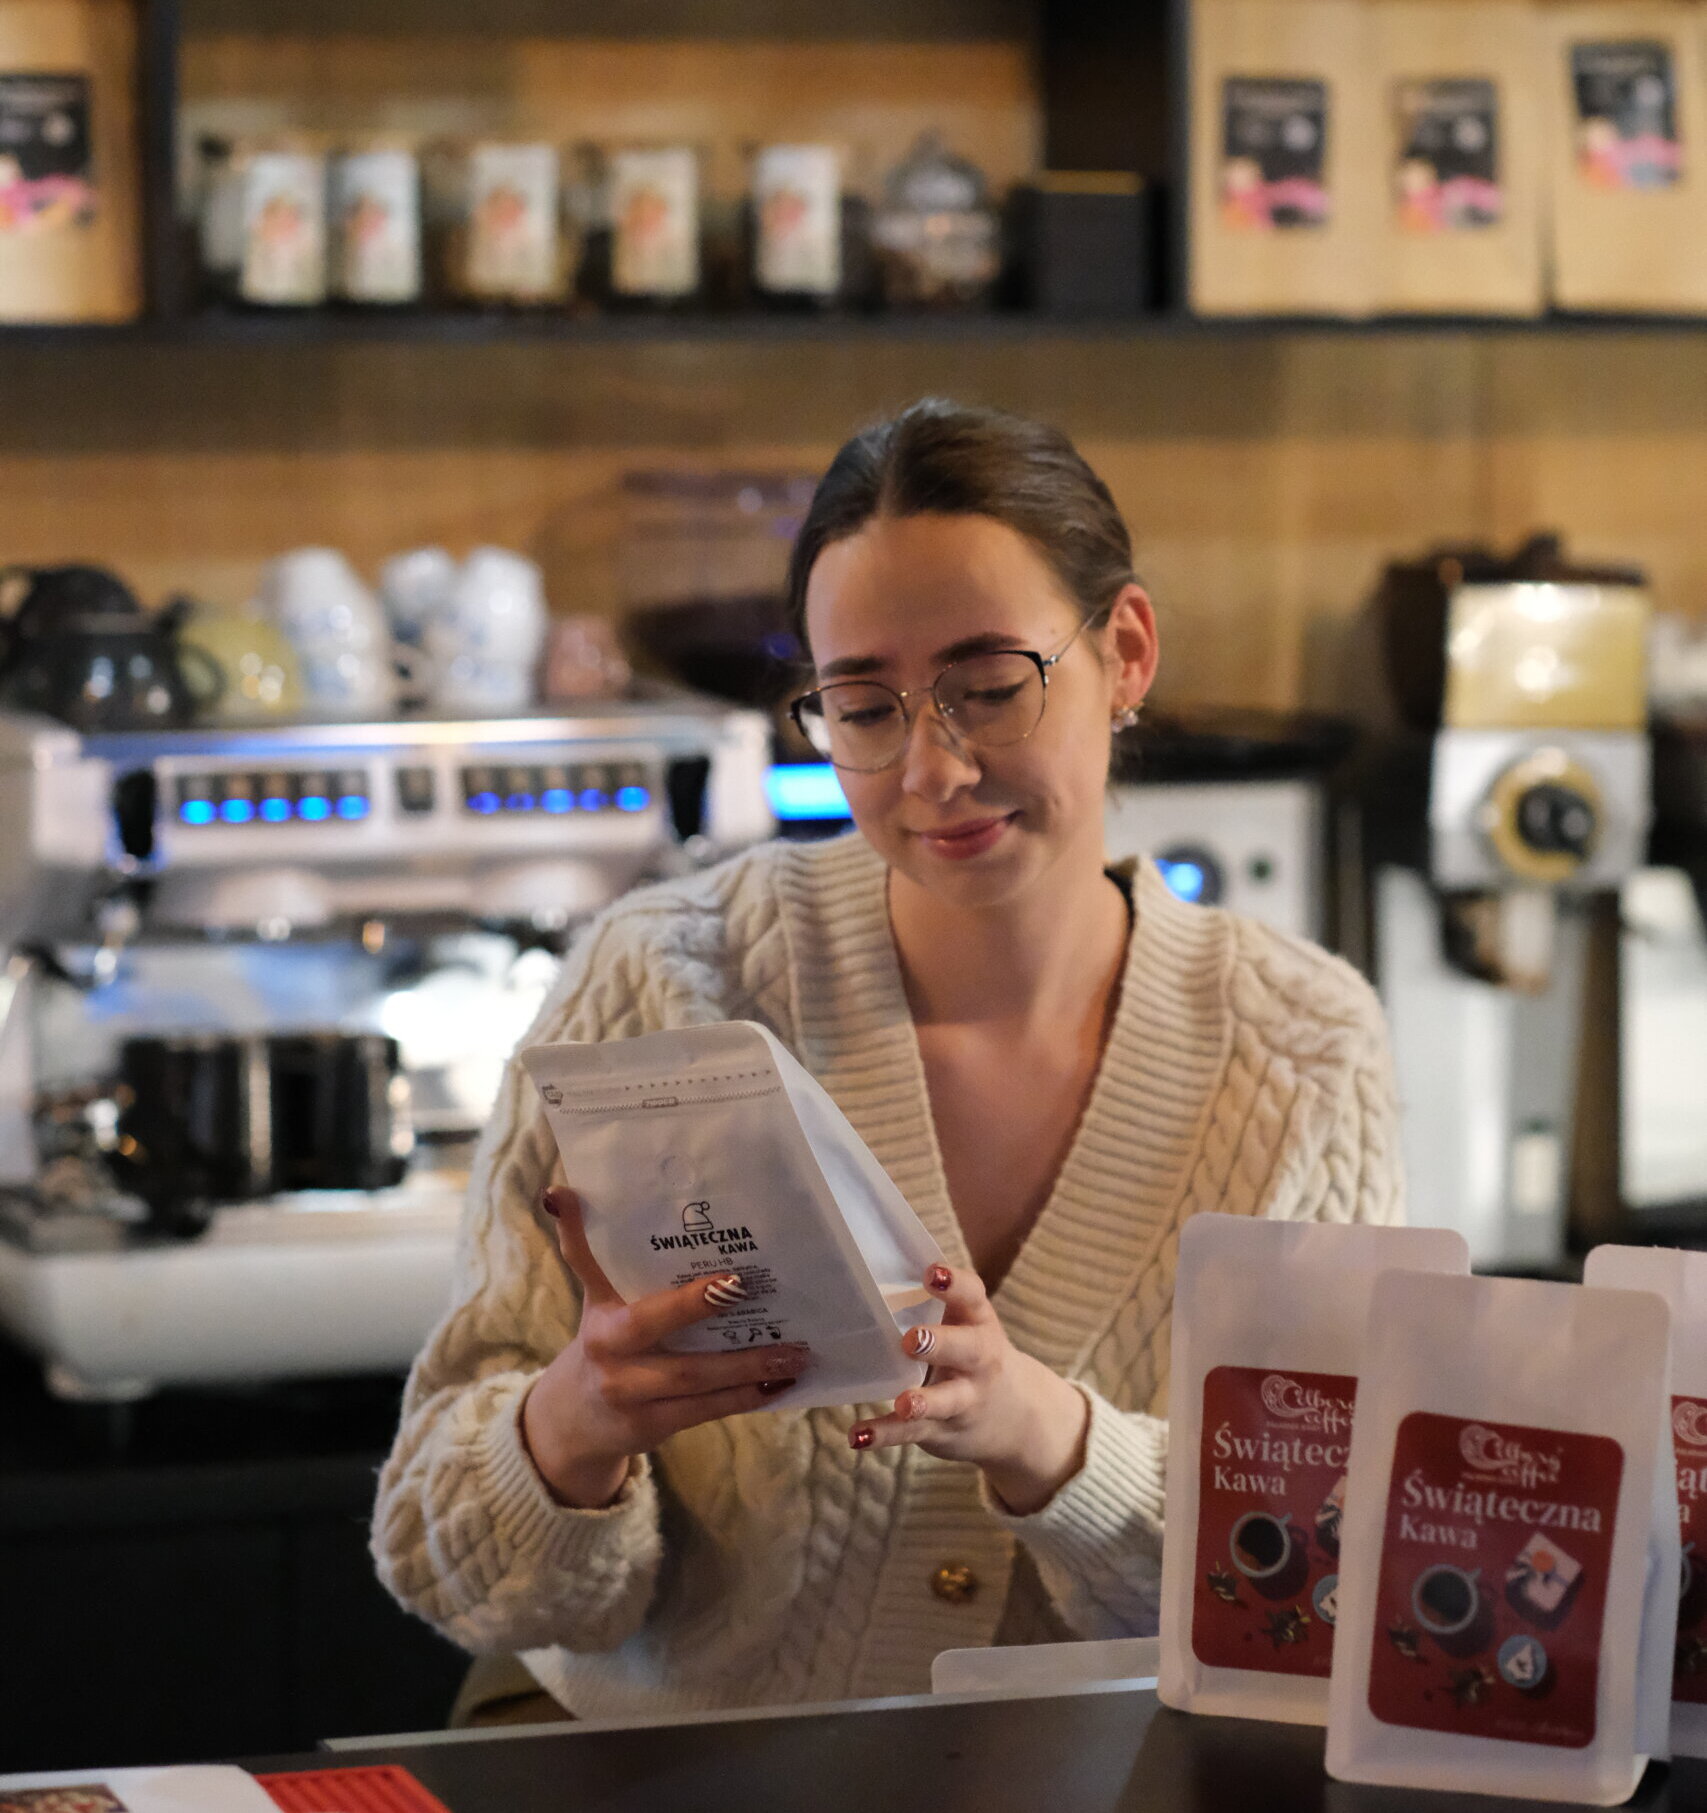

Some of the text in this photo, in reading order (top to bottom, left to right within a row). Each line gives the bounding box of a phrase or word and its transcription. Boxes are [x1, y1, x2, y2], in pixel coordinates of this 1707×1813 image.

[650, 1226, 752, 1251] ŚWIĄTECZNA
[718, 1241, 758, 1255] KAWA
[690, 1260, 717, 1269] PERU
[1213, 1422, 1350, 1471] Świątec
[1214, 1465, 1286, 1495] Kawa
[1402, 1469, 1601, 1533] Świąteczna
[1400, 1514, 1478, 1548] Kawa
